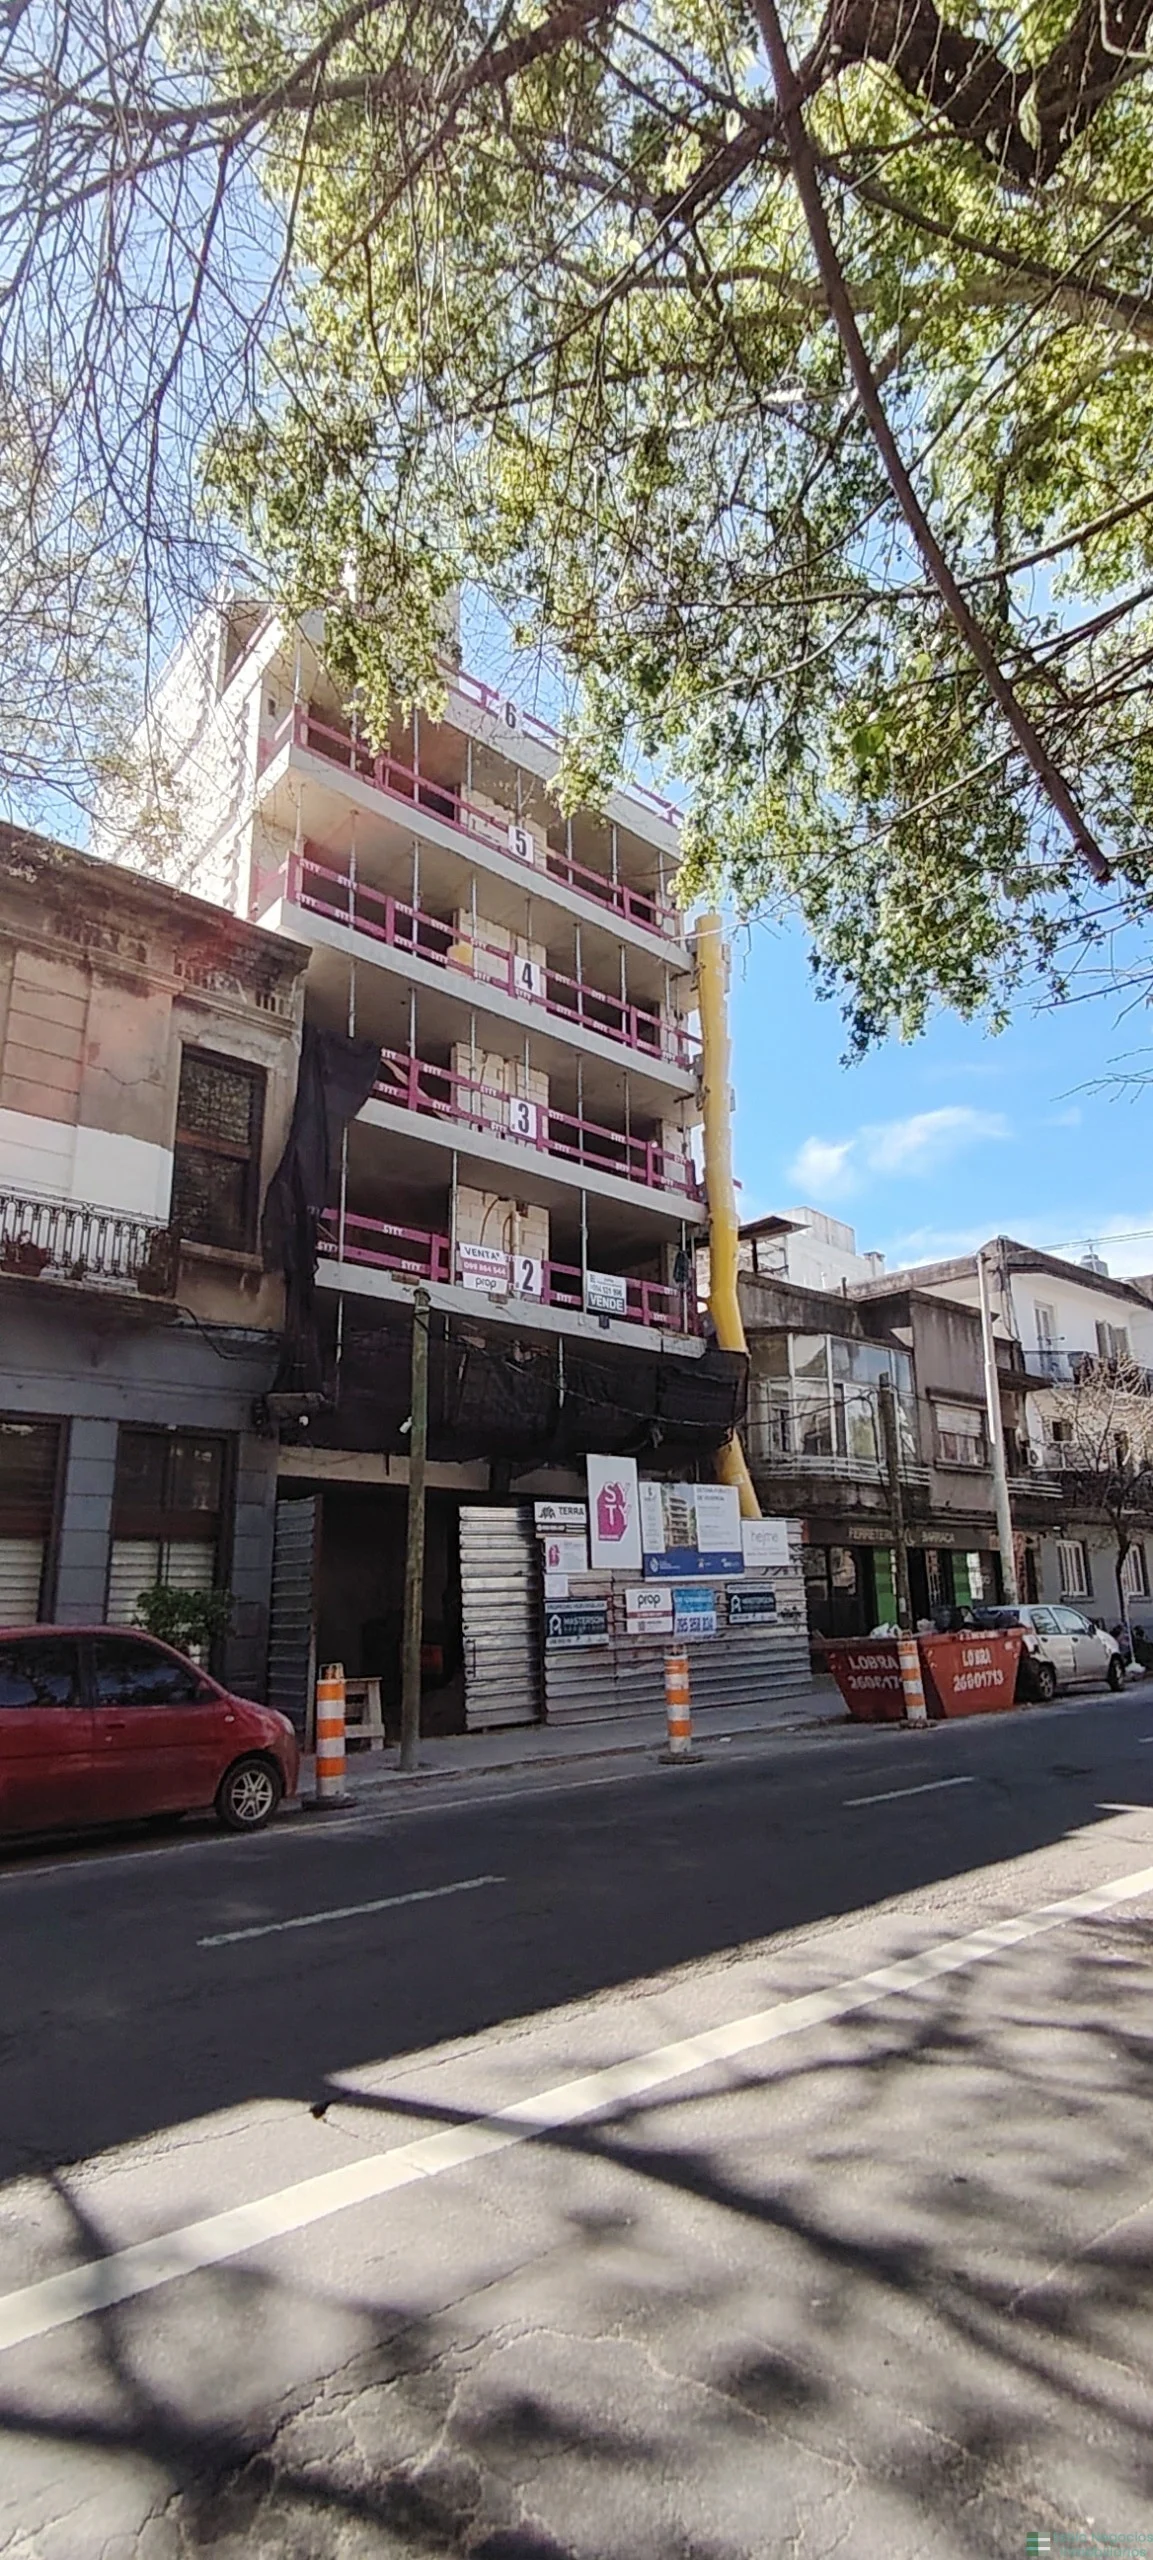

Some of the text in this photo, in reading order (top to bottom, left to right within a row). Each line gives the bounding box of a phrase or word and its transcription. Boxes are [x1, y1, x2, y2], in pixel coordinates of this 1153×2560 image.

[505, 701, 517, 729] 6
[515, 830, 527, 857] 5
[522, 962, 534, 990] 4
[517, 1102, 530, 1134] 3
[475, 1277, 497, 1291] prop
[521, 1259, 534, 1292] 2
[590, 1293, 624, 1312] VENDE
[558, 1506, 585, 1516] TERRA
[637, 1594, 661, 1609] prop
[848, 1655, 899, 1670] LOBRA
[962, 1647, 992, 1667] LOBRA
